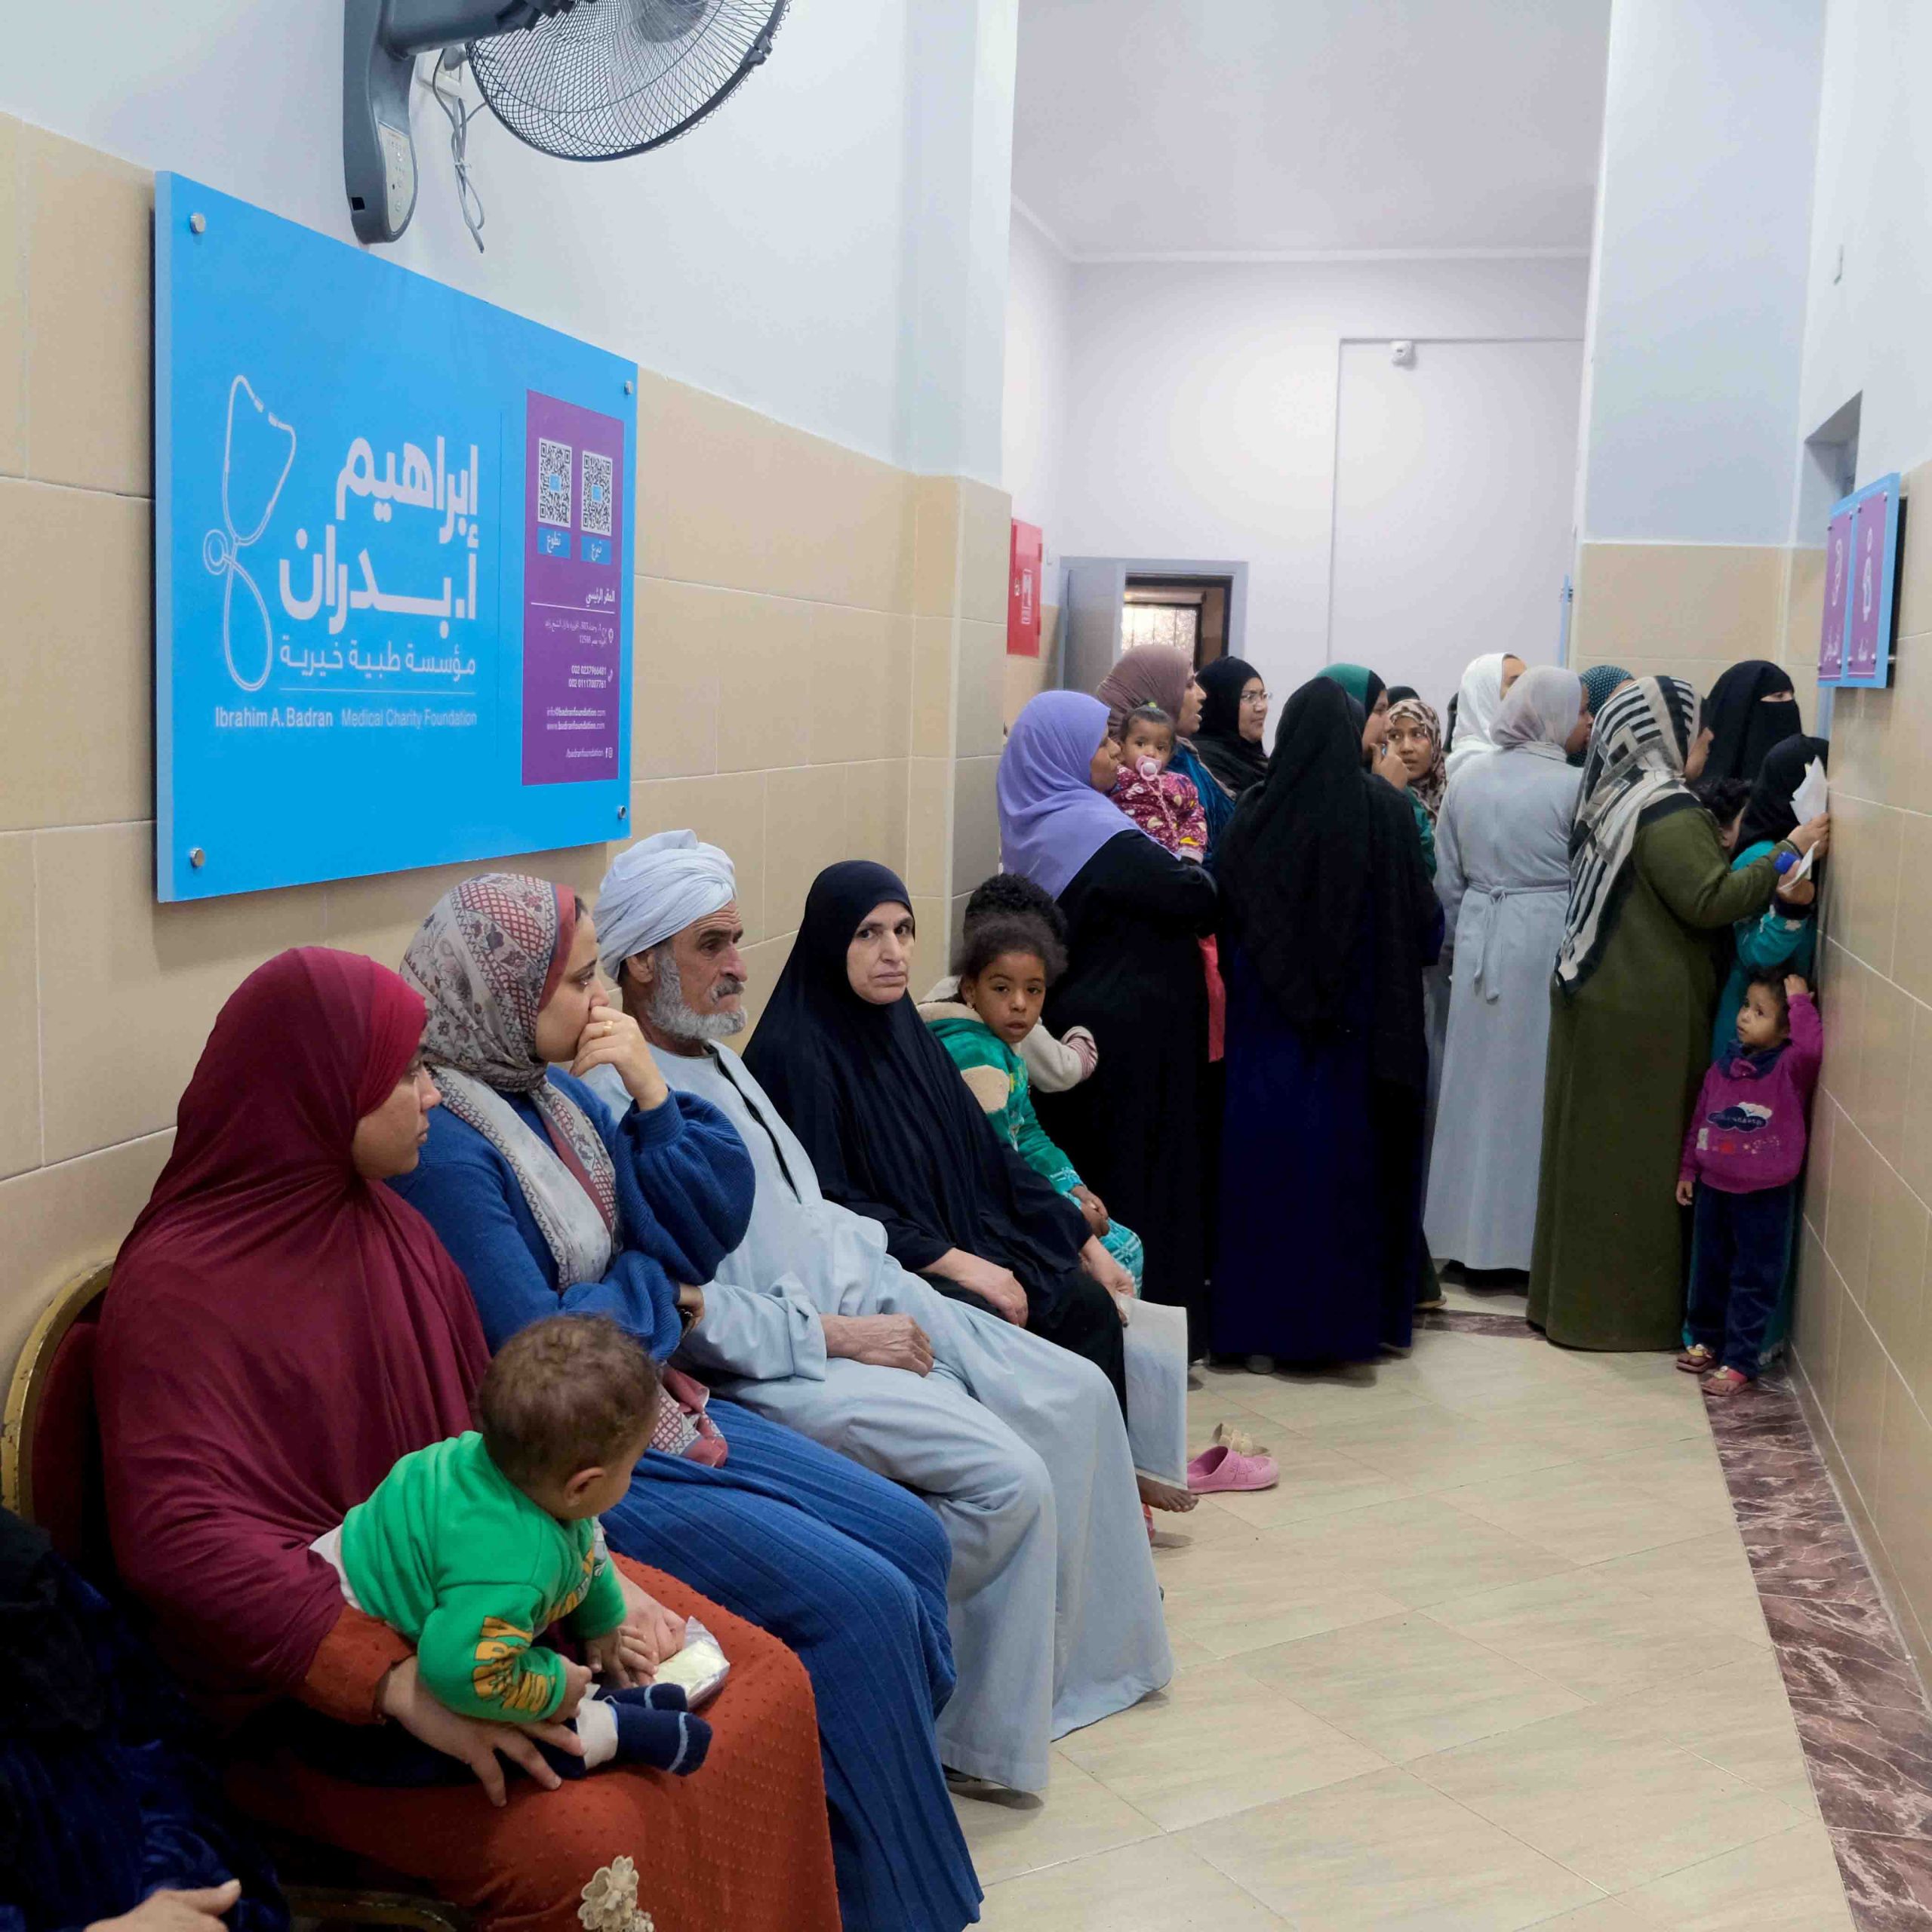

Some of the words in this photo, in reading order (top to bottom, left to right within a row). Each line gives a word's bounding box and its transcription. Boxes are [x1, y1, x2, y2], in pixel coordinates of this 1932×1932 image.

[280, 635, 343, 676] خيرية
[349, 639, 401, 678] طبية
[405, 643, 476, 682] مؤسسة
[215, 706, 268, 727] Ibrahim
[341, 709, 383, 726] Medical
[386, 709, 423, 729] Charity
[424, 709, 478, 725] Foundation
